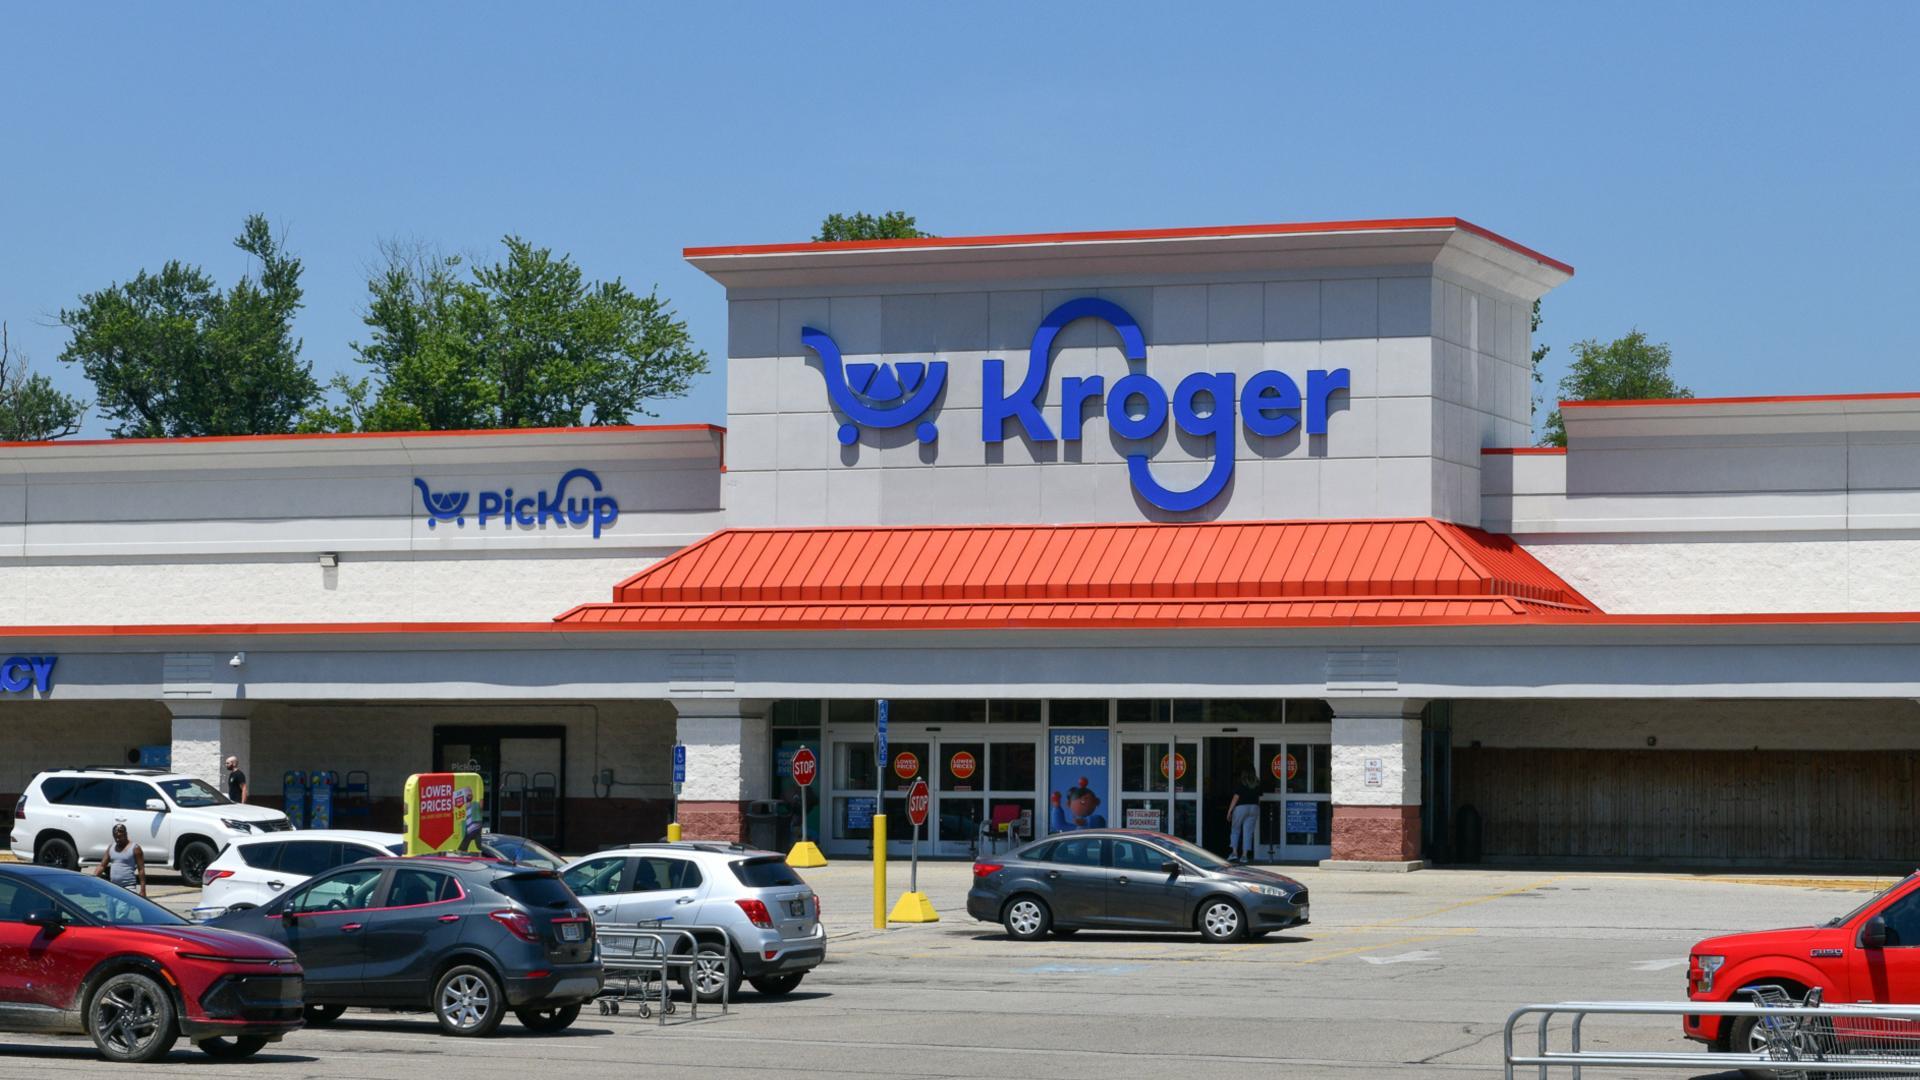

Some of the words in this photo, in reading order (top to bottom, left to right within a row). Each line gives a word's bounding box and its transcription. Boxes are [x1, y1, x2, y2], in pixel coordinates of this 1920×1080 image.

[982, 297, 1350, 512] Kroger
[0, 655, 58, 692] CY
[1054, 735, 1085, 744] FRESH
[1054, 745, 1075, 755] FOR
[794, 760, 815, 775] STOP
[1054, 756, 1106, 766] EVERYONE
[421, 785, 452, 799] LOWER
[420, 799, 452, 813] PRICES
[910, 795, 928, 811] STOP
